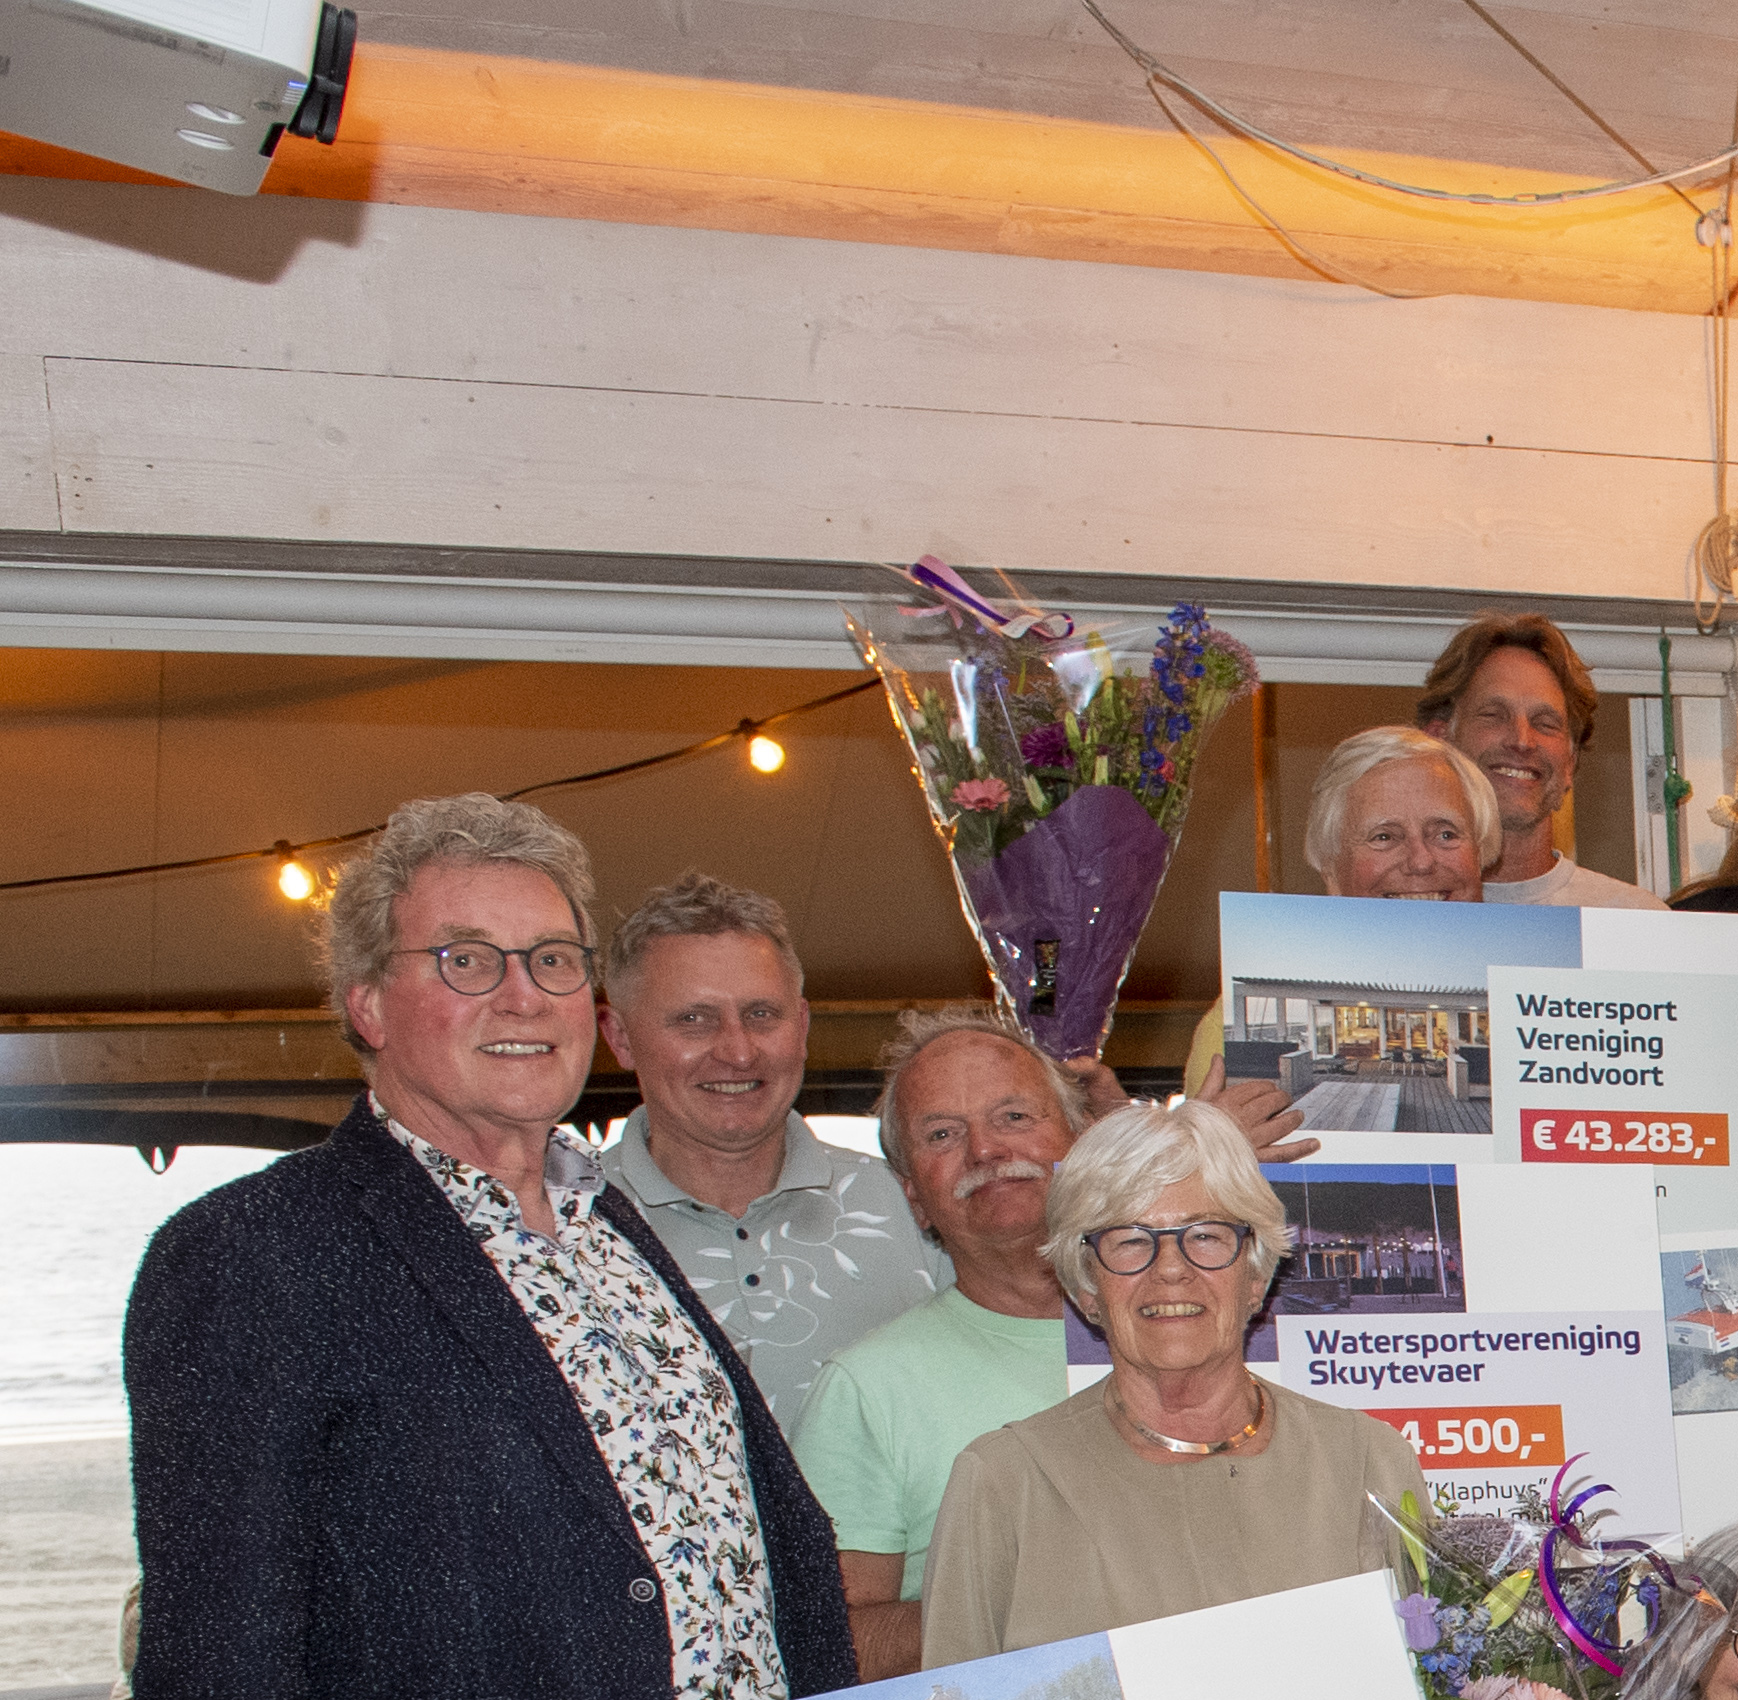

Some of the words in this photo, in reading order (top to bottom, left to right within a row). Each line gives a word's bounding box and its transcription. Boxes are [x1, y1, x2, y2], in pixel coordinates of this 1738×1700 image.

[1517, 994, 1677, 1025] Watersport
[1518, 1028, 1664, 1059] Vereniging
[1519, 1060, 1664, 1088] Zandvoort
[1564, 1120, 1716, 1161] 43.283,-
[1306, 1325, 1641, 1359] Watersportvereniging
[1309, 1360, 1485, 1390] Skuytevaer
